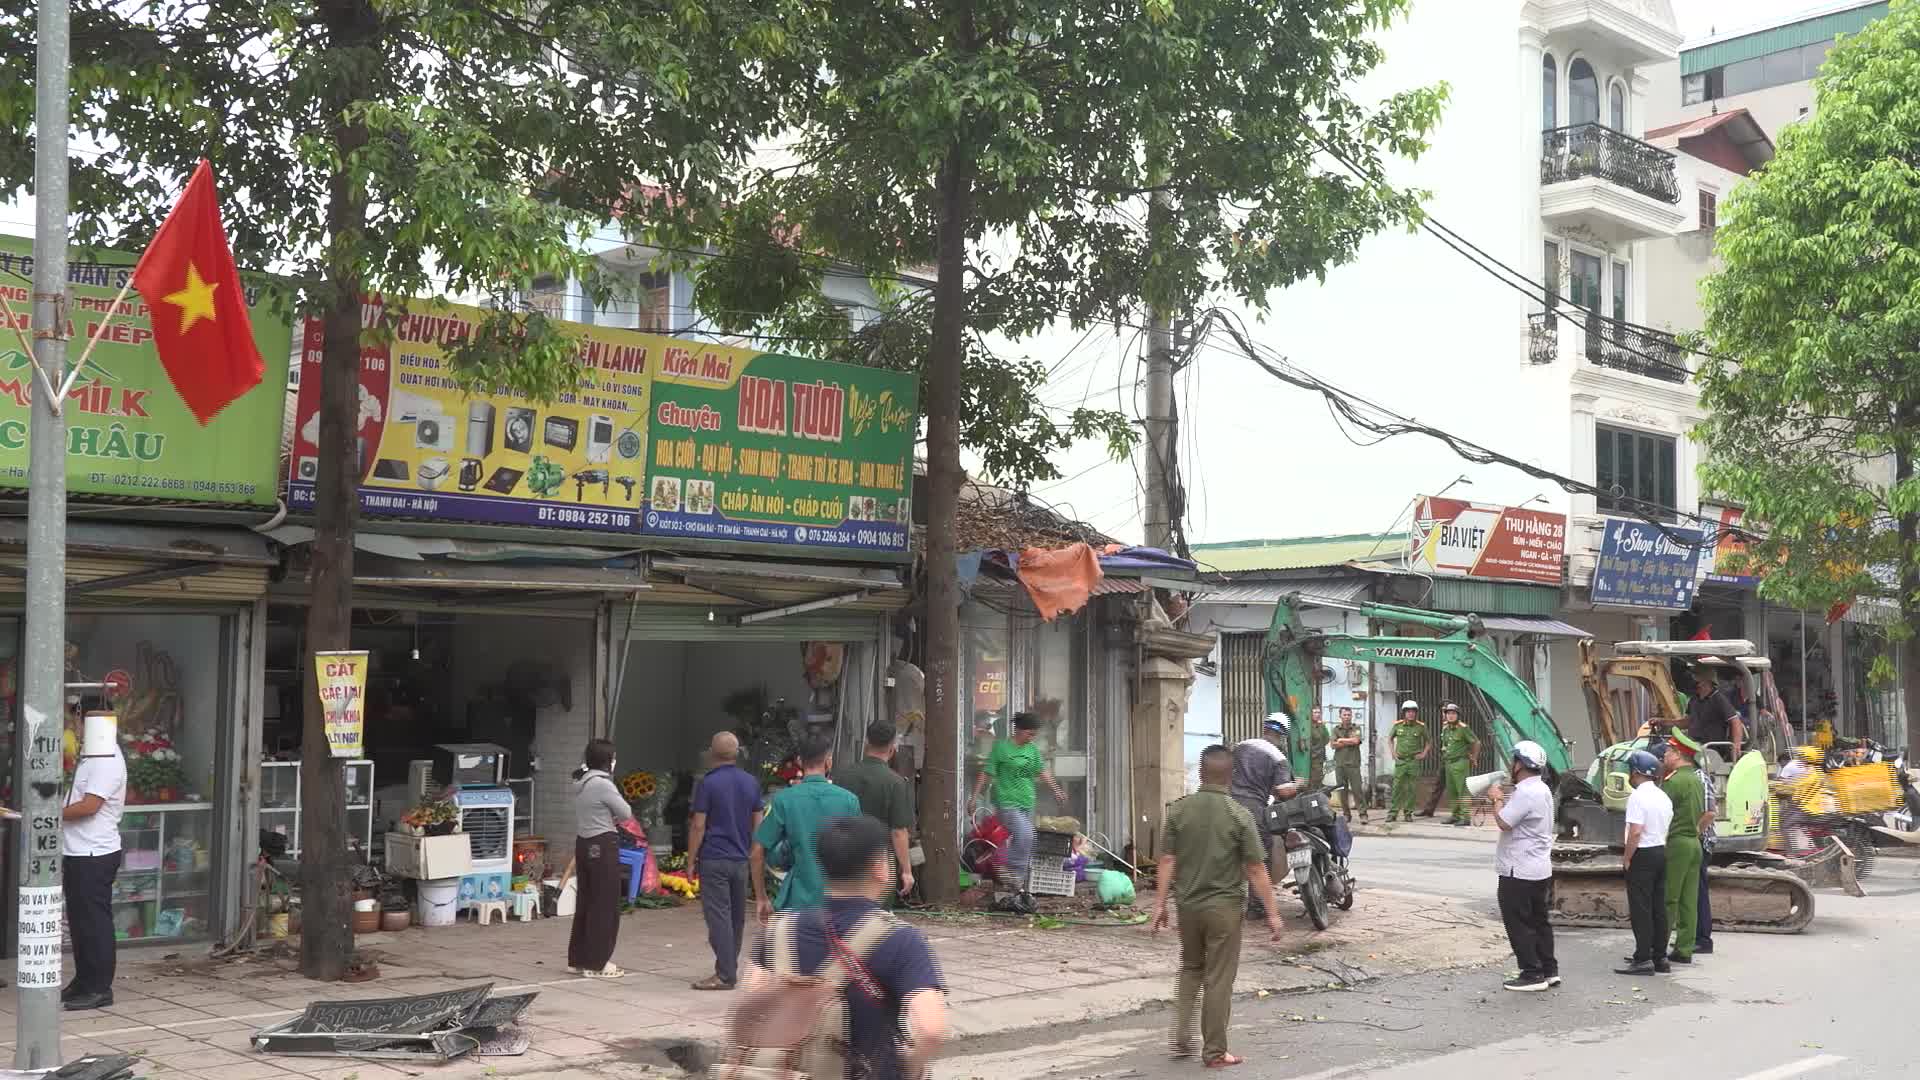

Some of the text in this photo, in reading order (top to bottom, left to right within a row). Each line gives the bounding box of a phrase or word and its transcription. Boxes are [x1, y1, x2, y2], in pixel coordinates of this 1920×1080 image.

[702, 353, 732, 380] Mai
[657, 401, 722, 432] Chuyên
[737, 374, 787, 436] HOA
[66, 423, 165, 461] HÂU
[656, 440, 673, 467] HOA
[558, 509, 585, 523] 0984
[587, 511, 608, 525] 252
[611, 514, 630, 527] 106
[1505, 517, 1524, 532] THU
[1553, 525, 1563, 537] 28
[808, 529, 821, 541] 076
[821, 530, 837, 542] 2266
[838, 531, 850, 542] 264
[857, 529, 877, 545] 0904
[878, 532, 891, 546] 106
[1441, 525, 1485, 552] BIA VIỆT
[1622, 528, 1654, 557] Shop
[1521, 551, 1537, 560] NGAN
[1376, 647, 1435, 659] YANMAR
[32, 894, 48, 905] VAY
[34, 944, 49, 955] VAY
